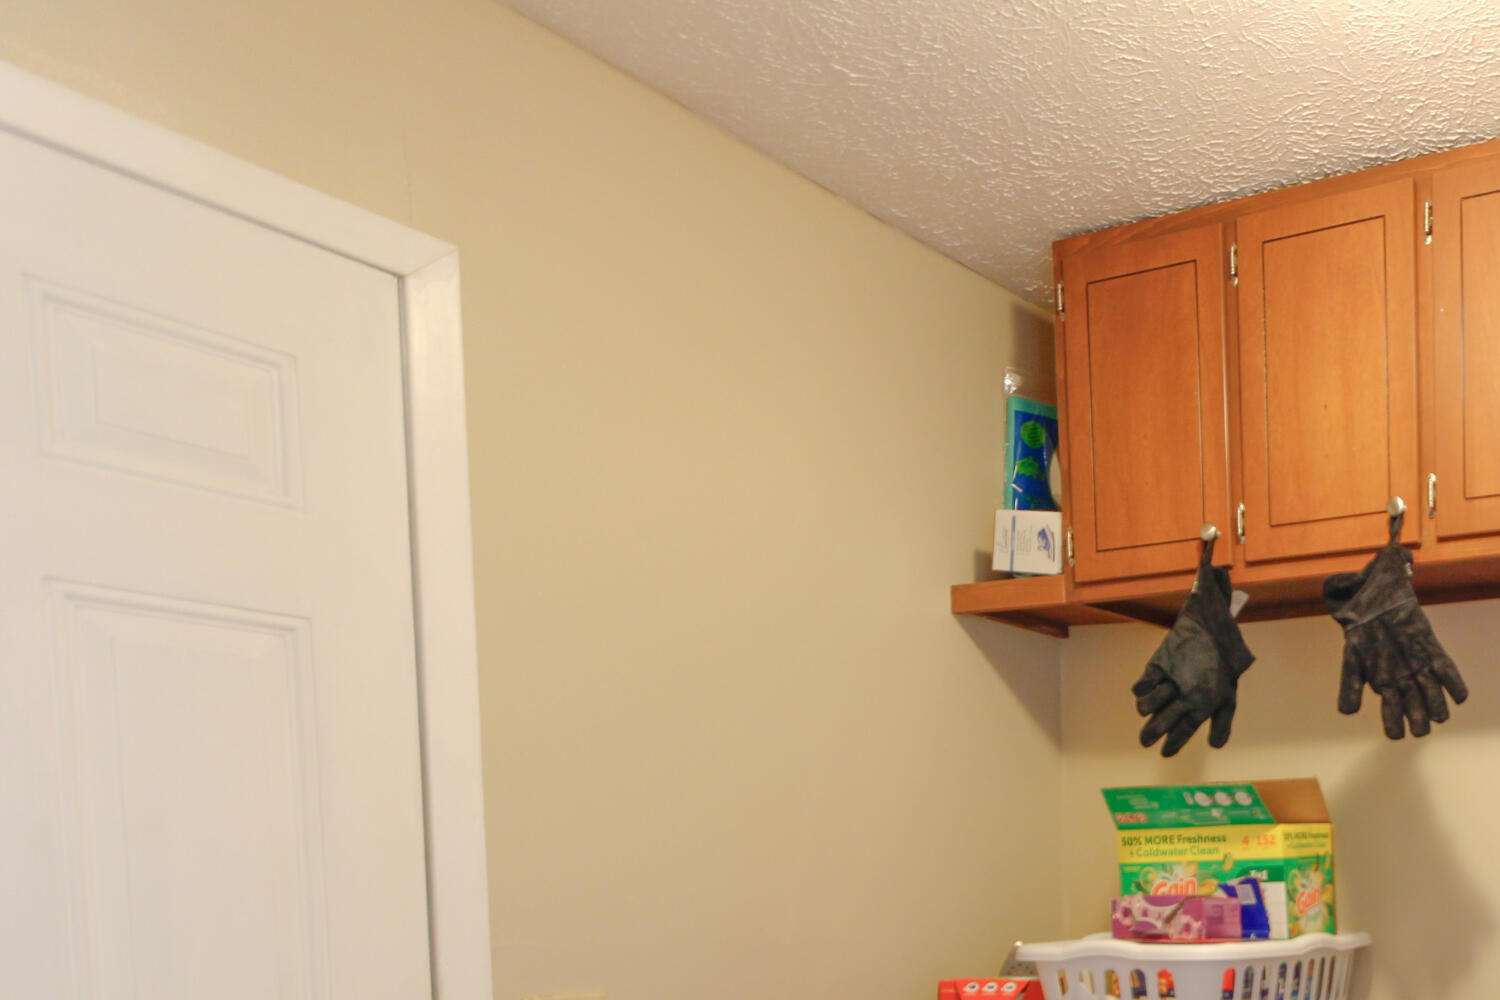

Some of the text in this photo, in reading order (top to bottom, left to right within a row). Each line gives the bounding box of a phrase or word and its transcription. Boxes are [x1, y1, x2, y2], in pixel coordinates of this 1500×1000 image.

[1121, 836, 1143, 847] 50%
[1144, 834, 1175, 846] MORE
[1176, 833, 1227, 844] Freshness
[1189, 844, 1219, 855] Clean
[1152, 877, 1197, 896] Gain
